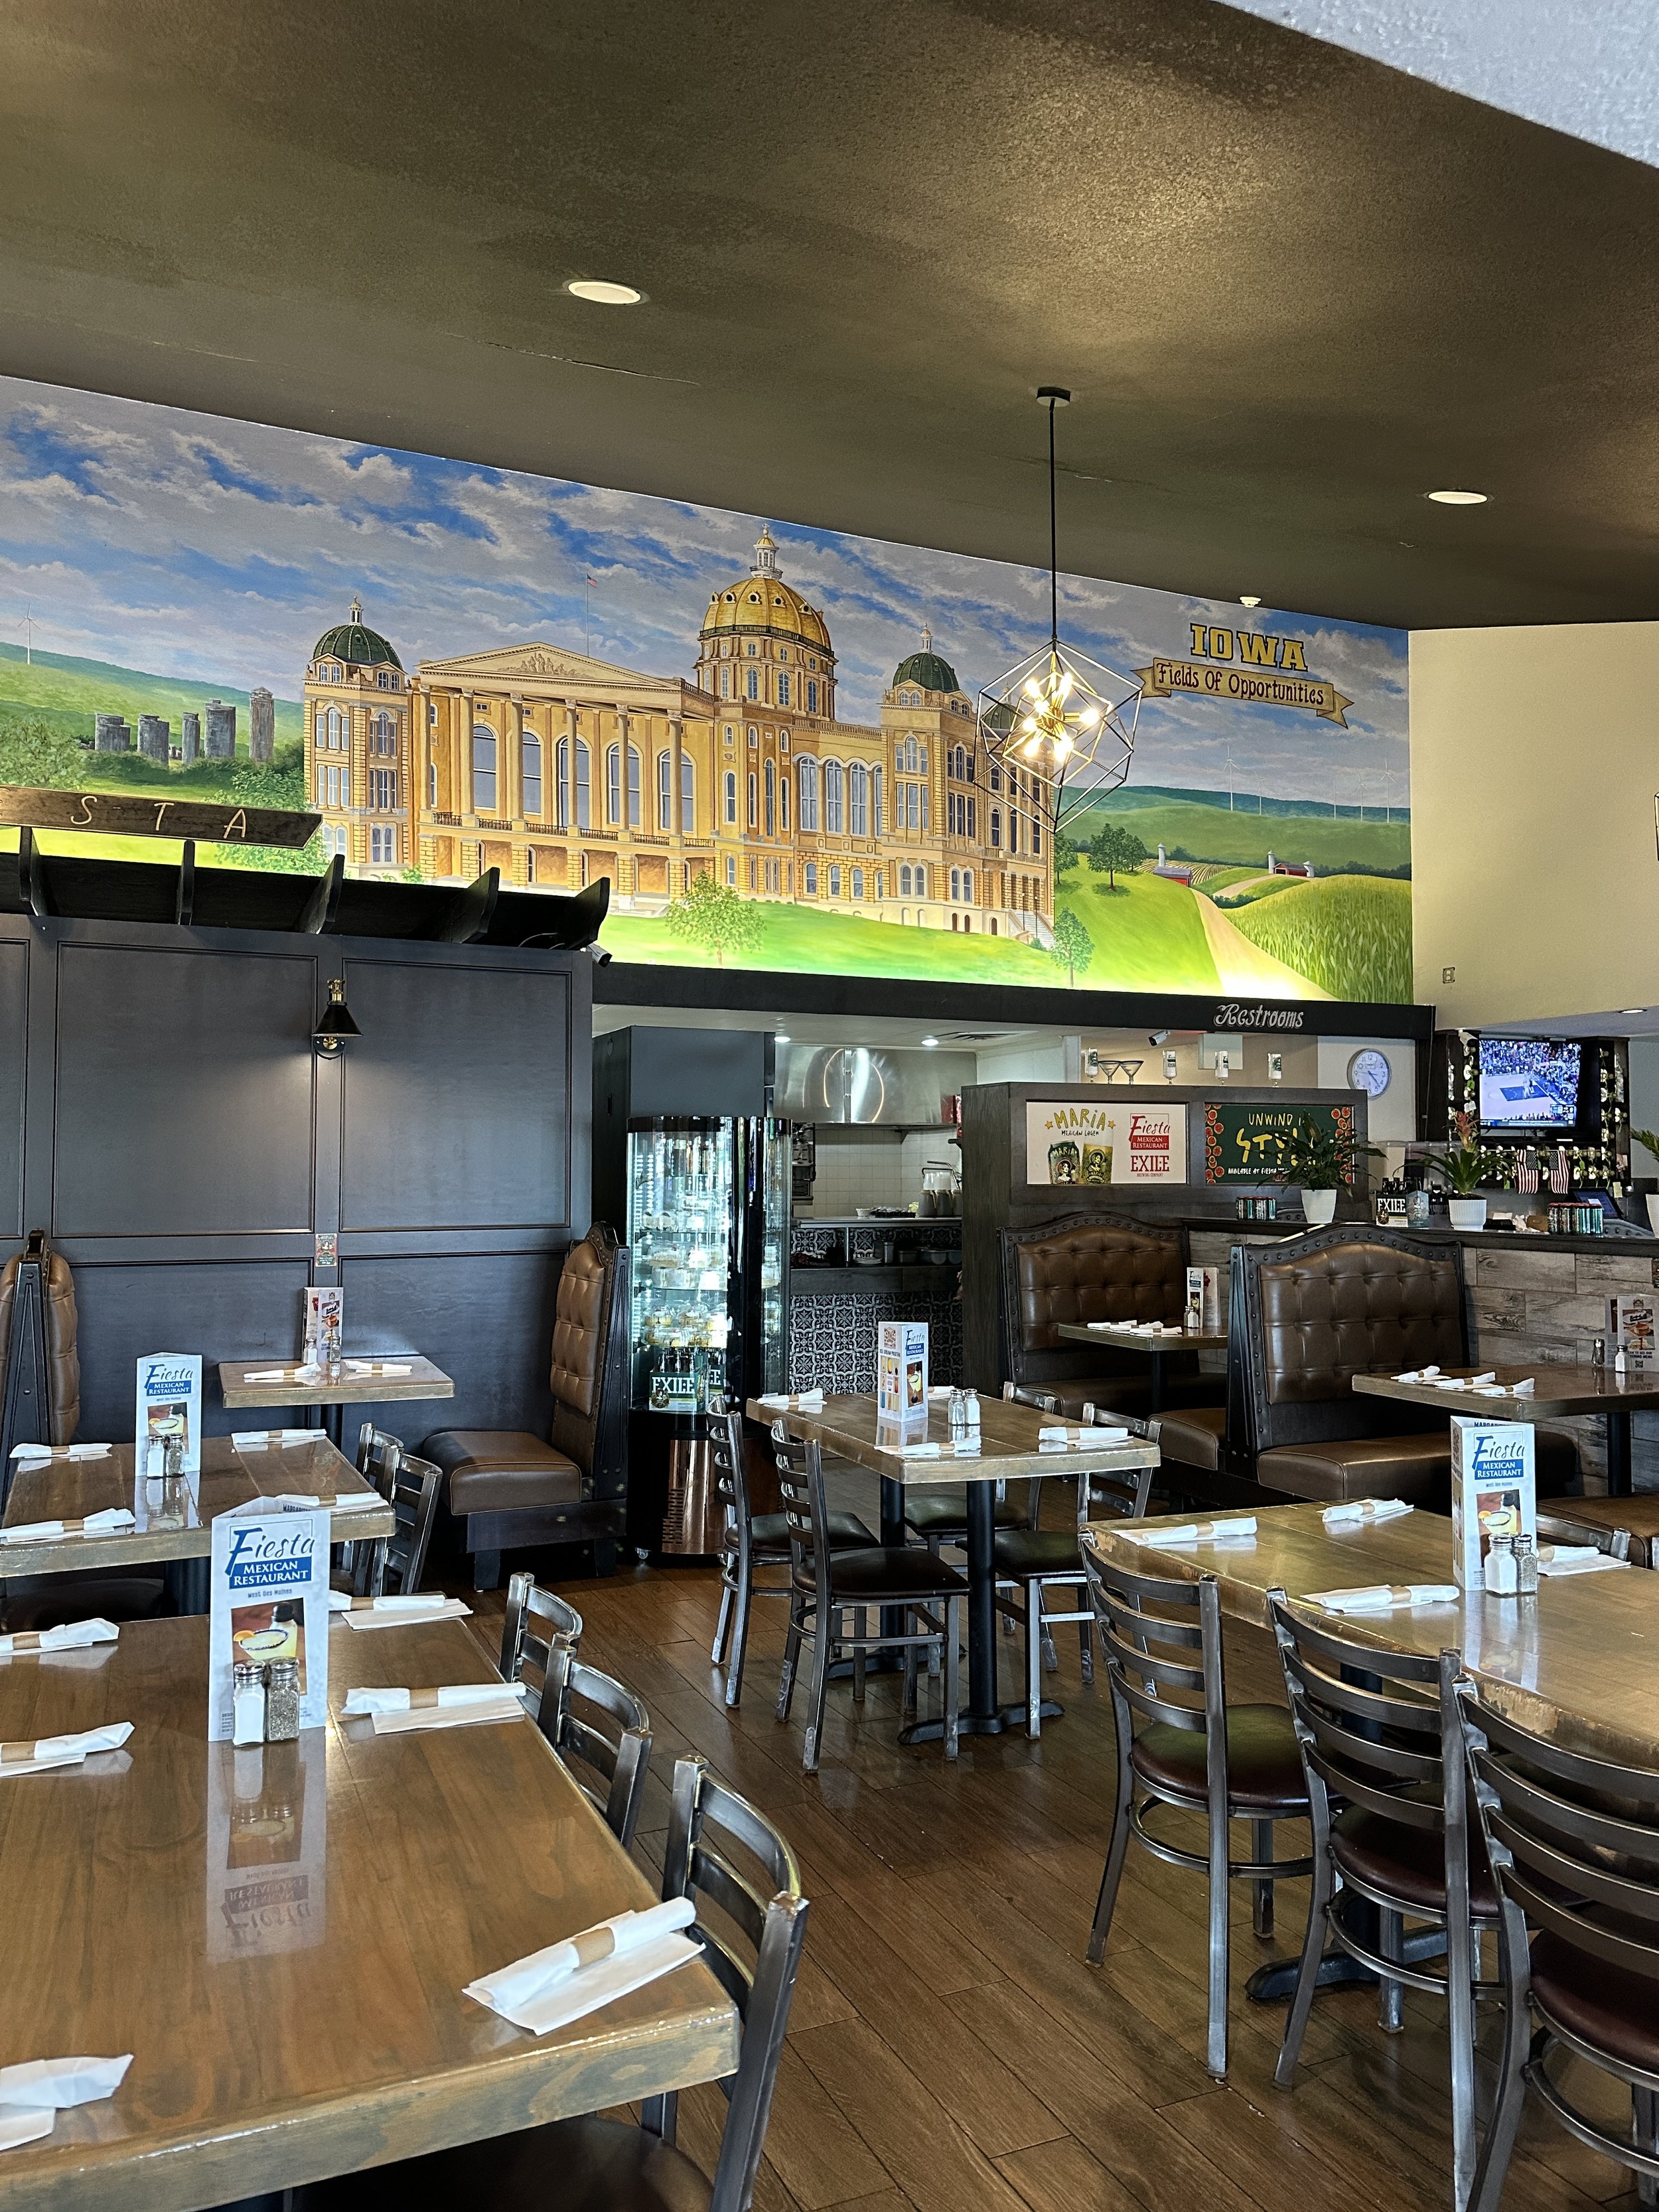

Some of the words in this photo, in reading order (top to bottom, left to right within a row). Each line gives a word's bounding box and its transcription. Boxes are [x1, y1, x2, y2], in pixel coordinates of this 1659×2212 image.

[1190, 623, 1308, 672] IOWA
[1156, 662, 1199, 688] Fields
[1204, 672, 1222, 691] Of
[1229, 674, 1325, 705] Opportunities
[1213, 1003, 1304, 1029] Restrooms
[1129, 1115, 1170, 1142] Fiesta
[1131, 1155, 1170, 1172] EXILE
[1377, 1198, 1406, 1213] EXILE
[905, 1329, 925, 1349] Fiesta
[144, 1364, 194, 1389] Fiesta
[652, 1376, 695, 1394] EXILE
[149, 1387, 190, 1396] RESTAURANT
[1472, 1435, 1526, 1471] Fiesta
[1477, 1469, 1522, 1478] RESTAURANT
[224, 1526, 316, 1576] Fiesta
[234, 1570, 309, 1585] RESTAURANT
[243, 1561, 298, 1575] MEXICAN
